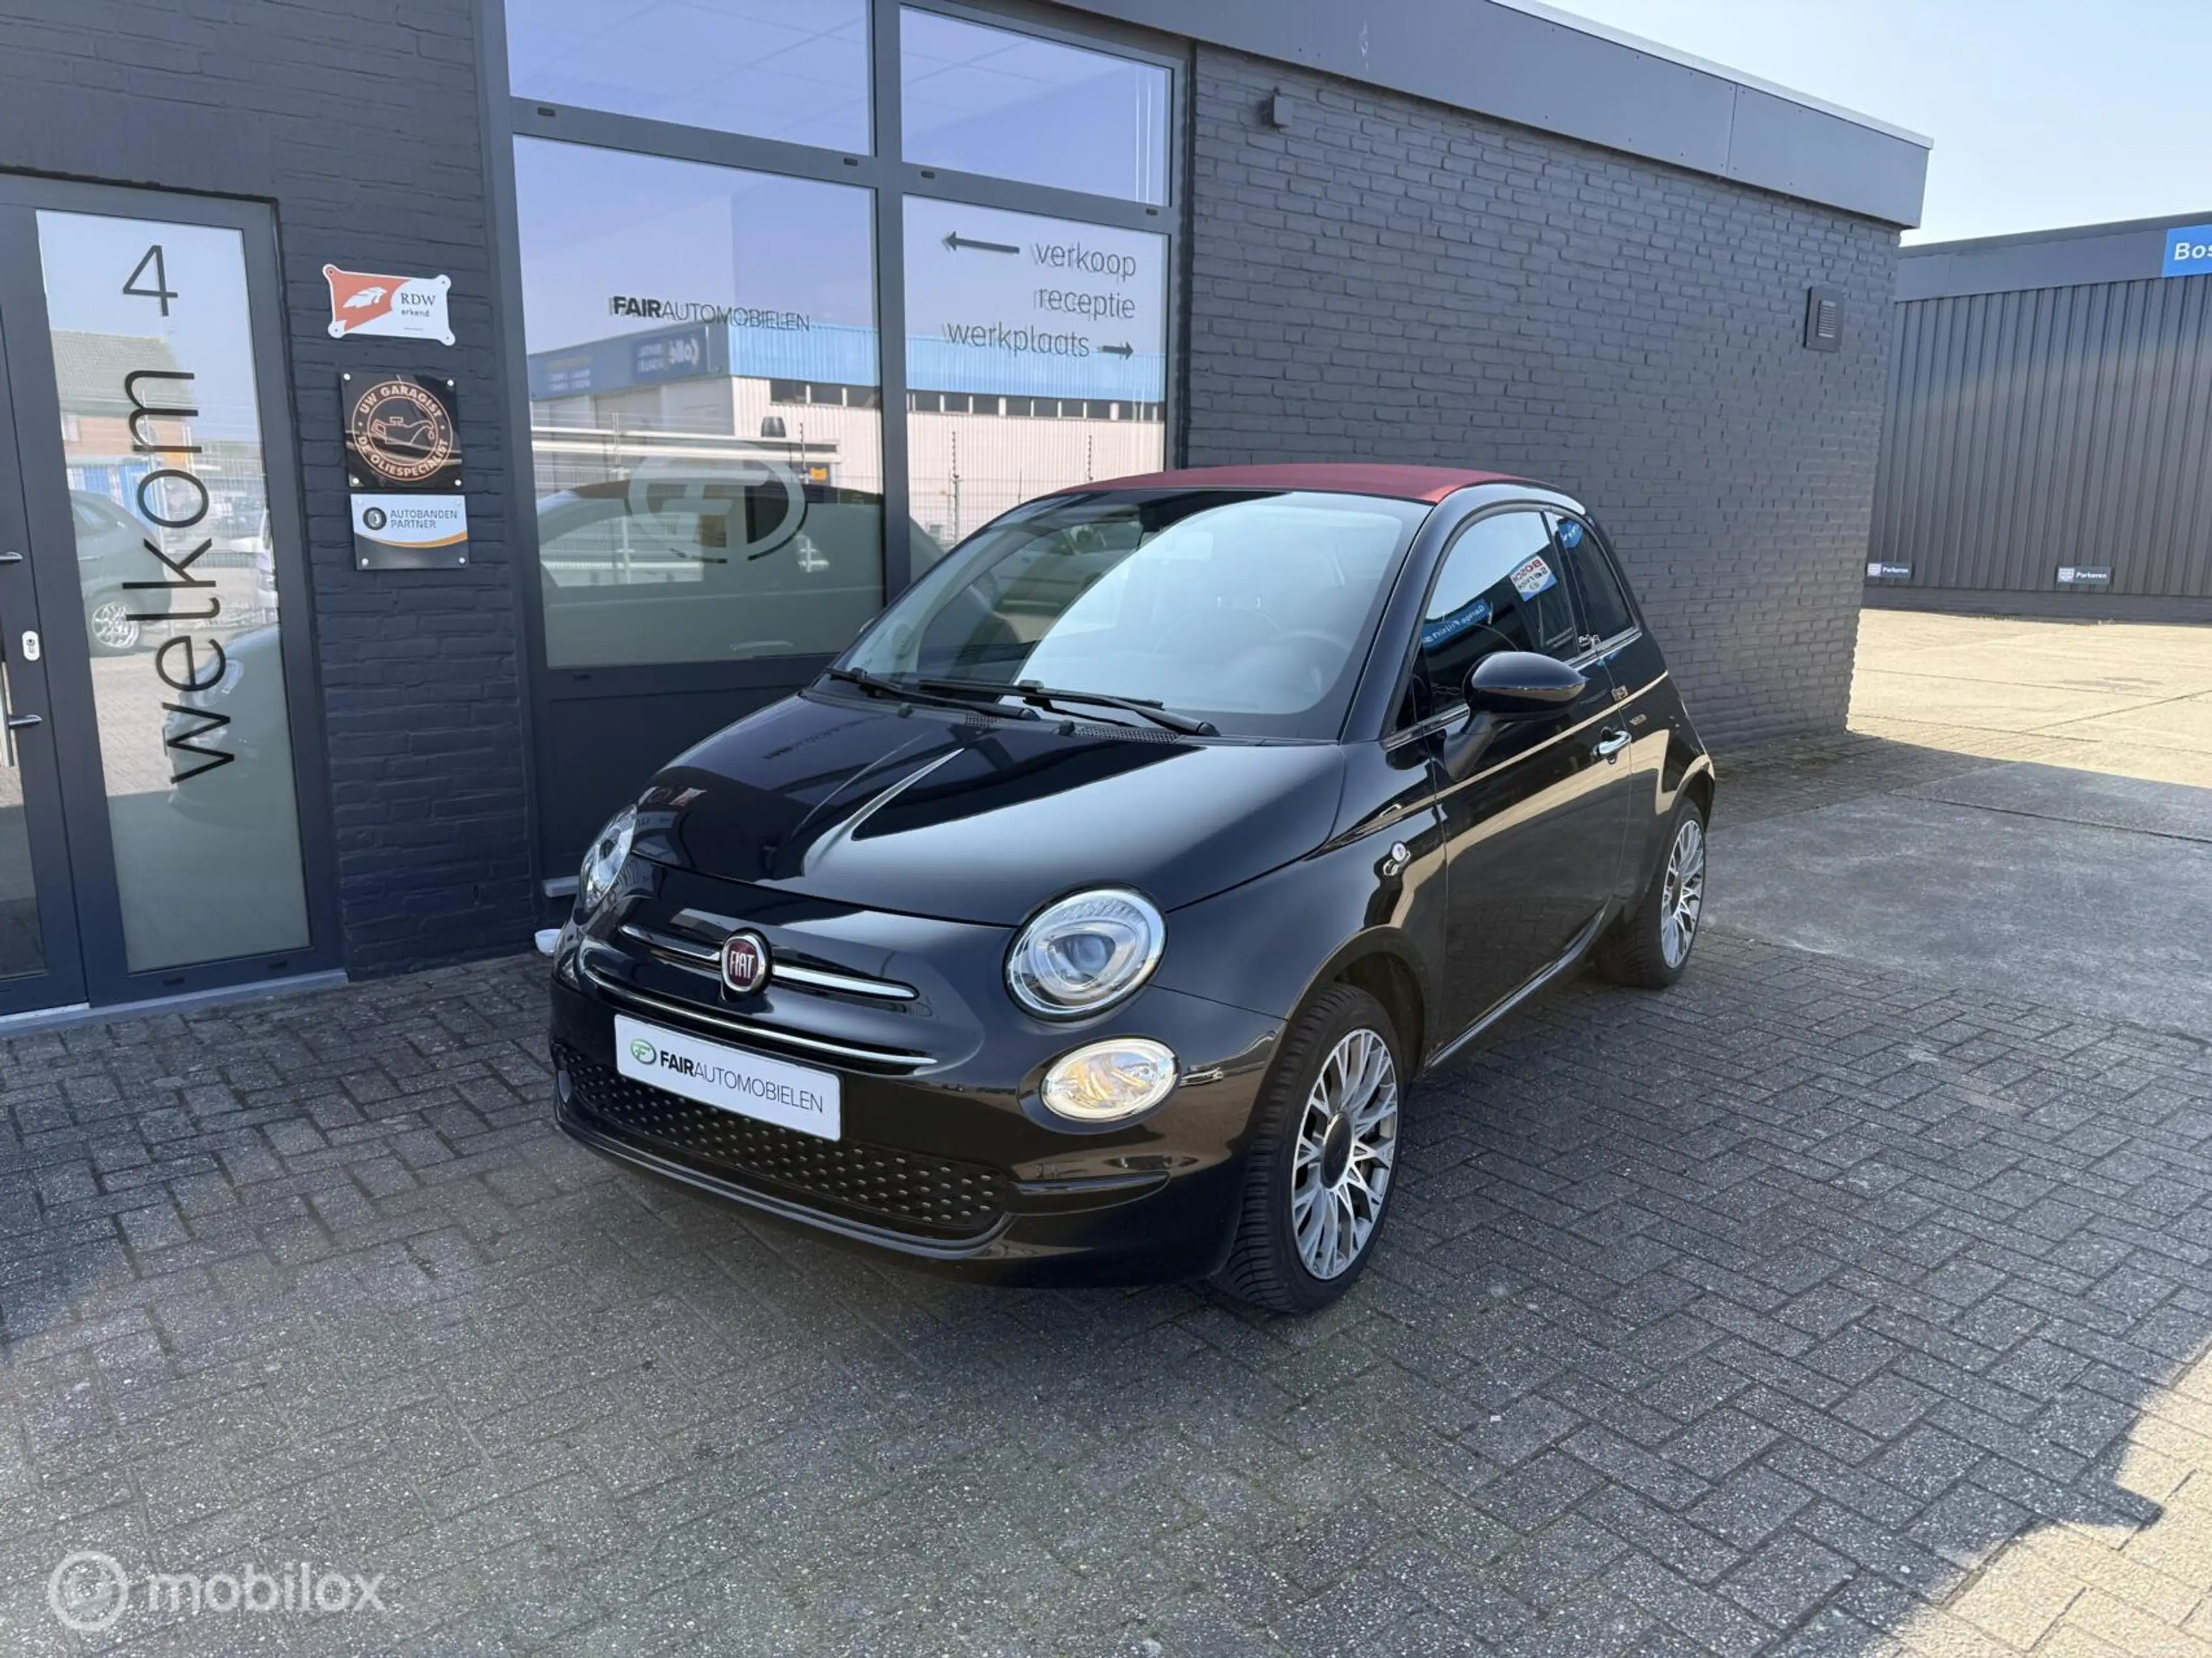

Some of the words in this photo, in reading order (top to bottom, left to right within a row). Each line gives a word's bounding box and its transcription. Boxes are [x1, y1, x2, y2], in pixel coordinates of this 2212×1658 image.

[1033, 241, 1137, 283] verkoop
[123, 244, 179, 317] 4
[401, 293, 436, 306] RDW
[402, 309, 430, 317] erkend
[612, 295, 810, 332] FAIRAUTOMOBIELEN
[1037, 287, 1137, 321] receptie
[945, 321, 1091, 358] werkplaats
[359, 392, 379, 415] UW
[380, 385, 443, 418] GARAGIST
[370, 438, 449, 477] OLIESPECIALIST
[390, 509, 458, 519] AUTOBANDEN
[391, 519, 437, 529] PARTNER
[123, 369, 236, 785] welkom
[729, 950, 755, 980] FIAT
[660, 1050, 824, 1114] FAIRAUTOMOBIELEN
